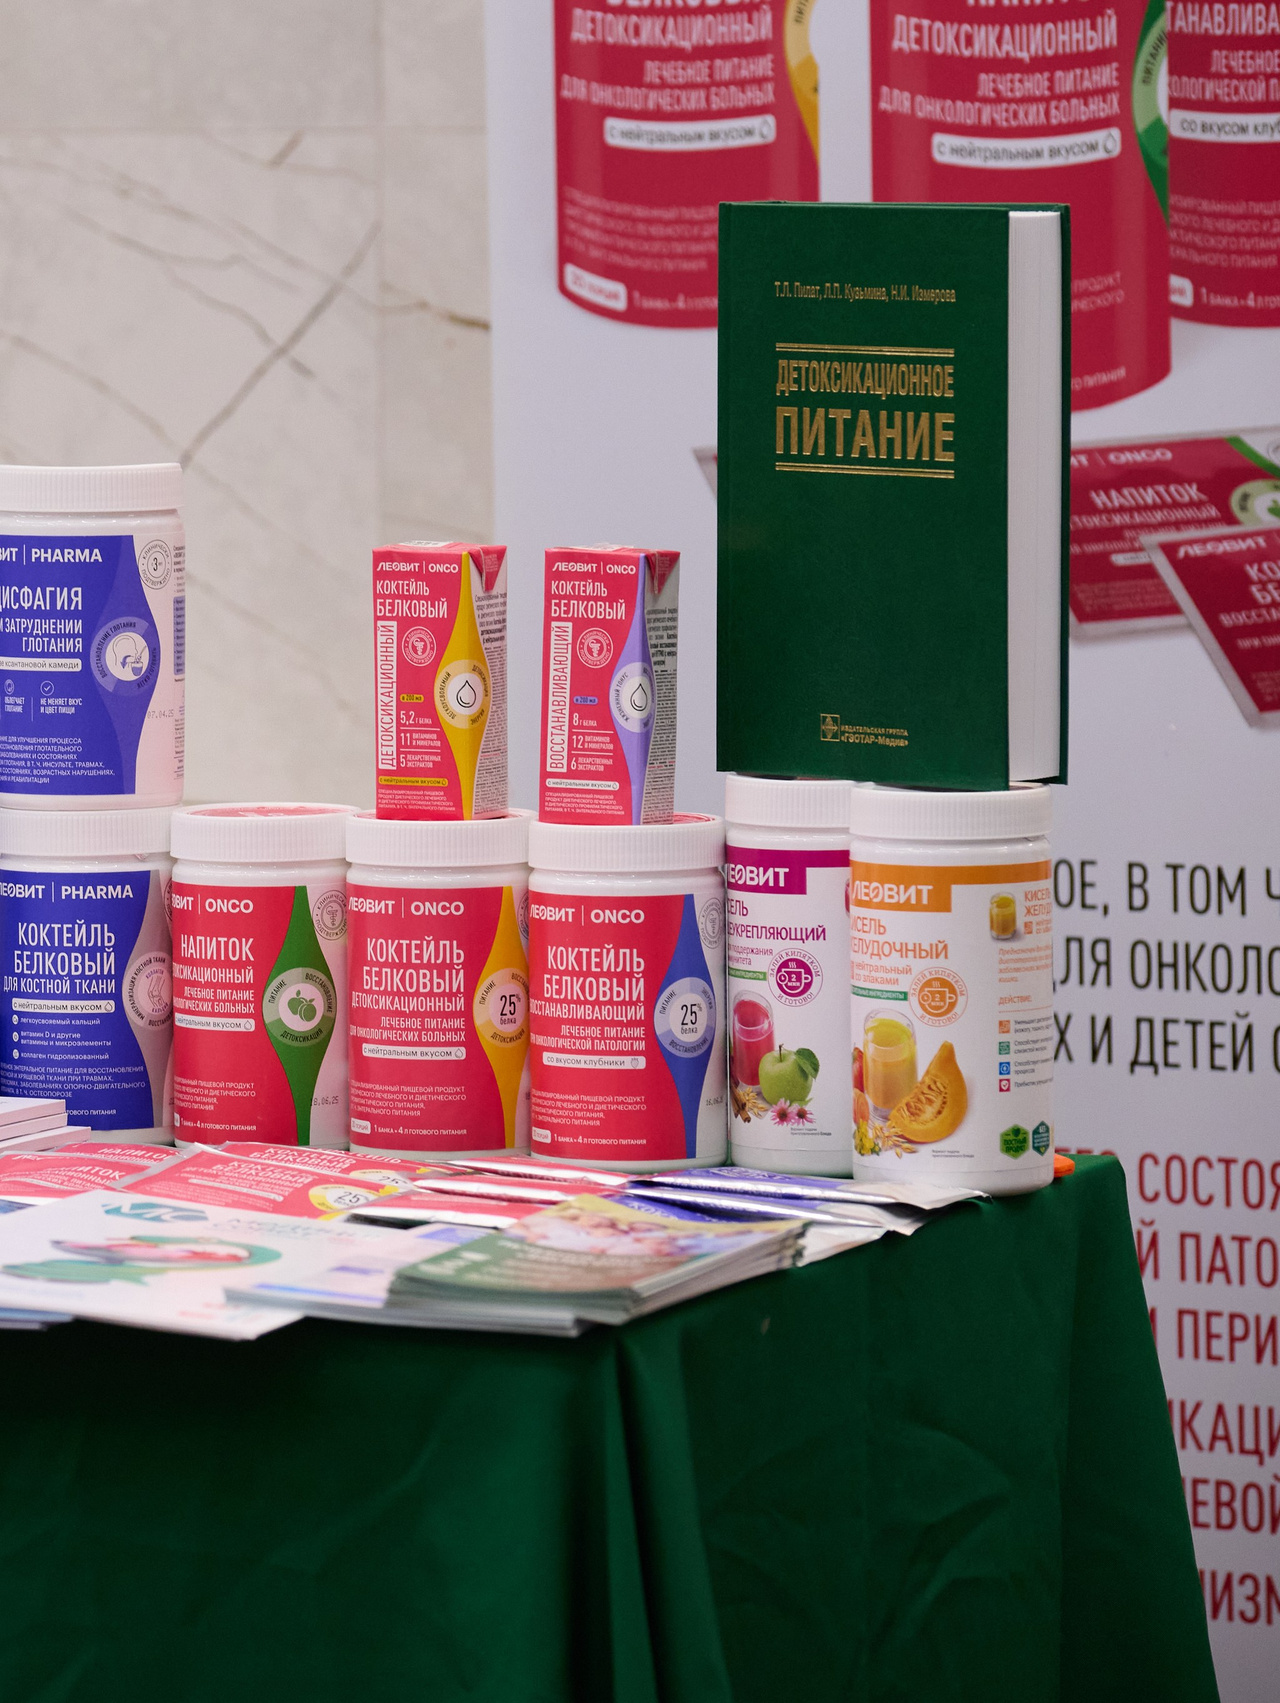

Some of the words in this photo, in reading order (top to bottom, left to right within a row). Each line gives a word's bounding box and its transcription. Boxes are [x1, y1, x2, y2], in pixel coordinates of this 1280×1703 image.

[892, 8, 1118, 64] ДЕТОКСИКАЦИОННЫЙ
[977, 71, 1051, 98] ЛЕЧЕБНОЕ
[1053, 62, 1119, 95] ПИТАНИЕ
[878, 85, 912, 114] ДЛЯ
[914, 94, 1048, 128] ОНКОЛОГИЧЕСКИХ
[1050, 92, 1120, 125] БОЛЬНЫХ
[775, 281, 792, 298] Т.Л.
[794, 281, 822, 300] Пилат,
[824, 283, 842, 299] Л.П.
[844, 283, 889, 302] Кузьмина,
[891, 285, 910, 301] Н.И.
[912, 285, 956, 305] Измерова
[776, 359, 955, 400] ДЕТОКСИКАЦИОННОЕ
[776, 406, 955, 462] ПИТАНИЕ
[1107, 448, 1173, 465] ONCO
[1089, 482, 1208, 510] НАПИТОК
[31, 548, 103, 563] PHARMA
[1177, 536, 1268, 559] ЛЕОВИТ
[376, 561, 420, 572] ЛЕОВИТ
[428, 563, 459, 573] ONCO
[552, 562, 598, 572] ЛЕОВИТ
[606, 564, 636, 575] ONCO
[376, 578, 430, 596] КОКТЕЙЛЬ
[551, 579, 608, 597] КОКТЕЙЛЬ
[376, 598, 448, 619] БЕЛКОВЫЙ
[551, 599, 626, 620] БЕЛКОВЫЙ
[5, 617, 82, 636] ЗАТРУДНЕНИИ
[22, 637, 83, 653] ГЛОТАНИЯ
[5, 659, 47, 670] ксантановой
[49, 661, 80, 670] камеди
[377, 624, 396, 768] ДЕТОКСИКАЦИОННЫЙ
[549, 625, 572, 770] ВОССТАНАВЛИВАЮЩИЙ
[61, 885, 133, 899] PHARMA
[852, 880, 934, 905] ЛЕОВИТ
[1127, 862, 1149, 912] В
[1165, 864, 1247, 917] ТОМ
[205, 898, 254, 914] ONCO
[348, 896, 396, 914] ЛЕОВИТ
[410, 901, 465, 916] ONCO
[529, 904, 575, 922] ЛЕОВИТ
[590, 909, 645, 924] ONCO
[18, 919, 116, 947] КОКТЕЙЛЬ
[181, 933, 255, 962] НАПИТОК
[366, 935, 465, 964] КОКТЕЙЛЬ
[547, 943, 645, 972] КОКТЕЙЛЬ
[14, 947, 115, 976] БЕЛКОВЫЙ
[4, 975, 18, 993] ДЛЯ
[20, 976, 70, 994] КОСТНОЙ
[74, 978, 115, 994] ТКАНИ
[363, 964, 465, 993] БЕЛКОВЫЙ
[543, 973, 645, 1002] БЕЛКОВЫЙ
[183, 986, 215, 1000] ЛЕЧЕБНОЕ
[216, 989, 255, 1001] ПИТАНИЕ
[351, 991, 465, 1014] ДЕТОКСИКАЦИОННЫЙ
[214, 1001, 255, 1014] БОЛЬНЫХ
[380, 1016, 422, 1029] ЛЕЧЕБНОЕ
[424, 1017, 466, 1029] ПИТАНИЕ
[560, 1024, 602, 1037] ЛЕЧЕБНОЕ
[604, 1026, 646, 1038] ПИТАНИЕ
[1091, 1013, 1113, 1065] И
[1130, 1010, 1254, 1076] ДЕТЕЙ
